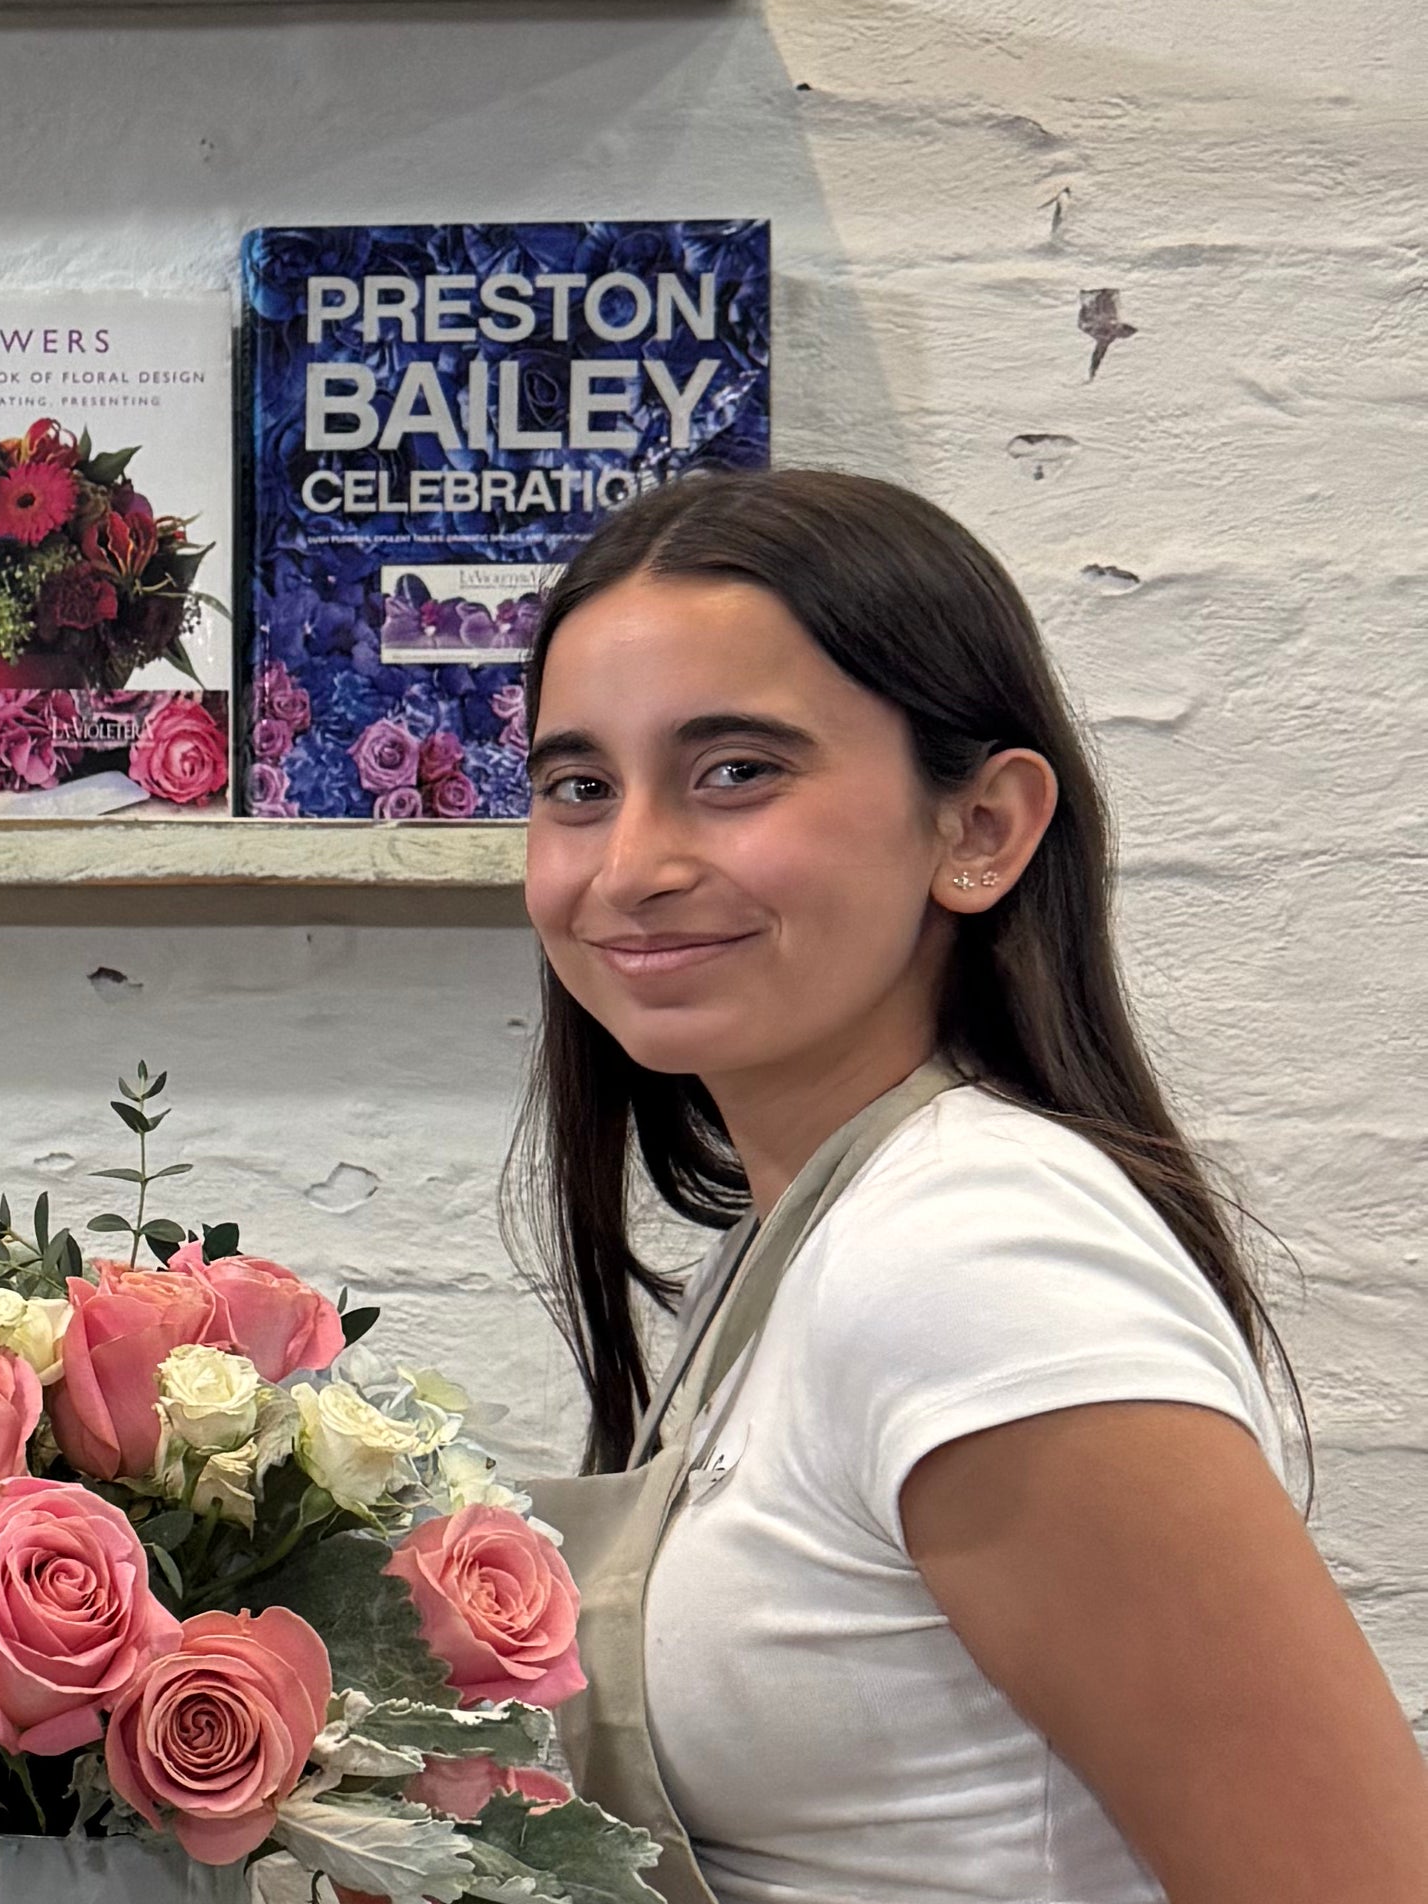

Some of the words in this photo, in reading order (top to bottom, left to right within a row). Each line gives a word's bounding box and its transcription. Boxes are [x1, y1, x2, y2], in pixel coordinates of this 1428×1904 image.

[306, 271, 717, 344] PRESTON
[30, 371, 53, 384] OF
[61, 371, 130, 384] FLORAL
[138, 371, 206, 384] DESIGN
[60, 396, 162, 407] PRESENTING
[304, 358, 722, 452] BAILEY
[301, 469, 697, 514] CELEBRATIO
[71, 716, 155, 739] VIOLETERA
